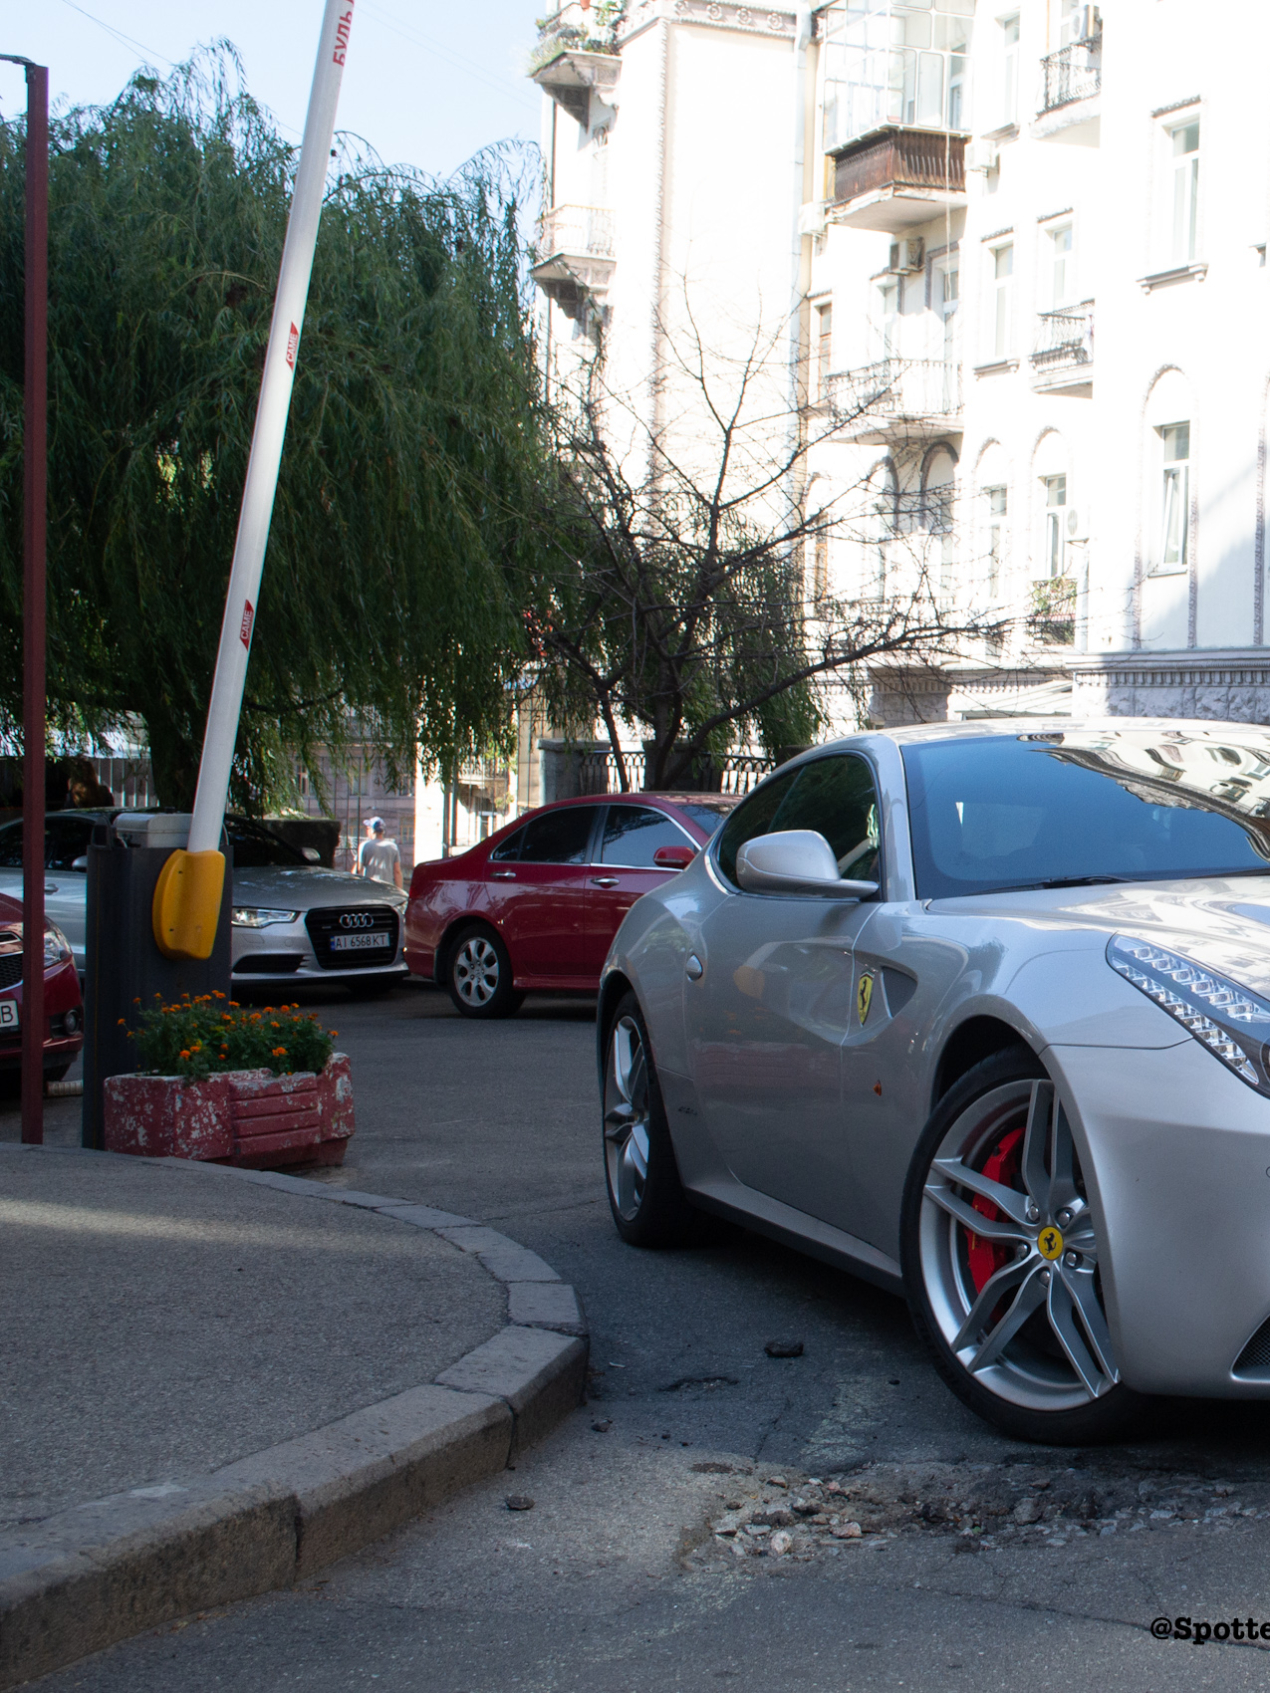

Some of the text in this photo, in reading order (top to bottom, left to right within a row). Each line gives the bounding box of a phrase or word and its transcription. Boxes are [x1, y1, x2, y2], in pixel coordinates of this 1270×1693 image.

[286, 333, 298, 362] CAME
[241, 610, 253, 640] CAME
[336, 934, 386, 949] AI 6568 KT
